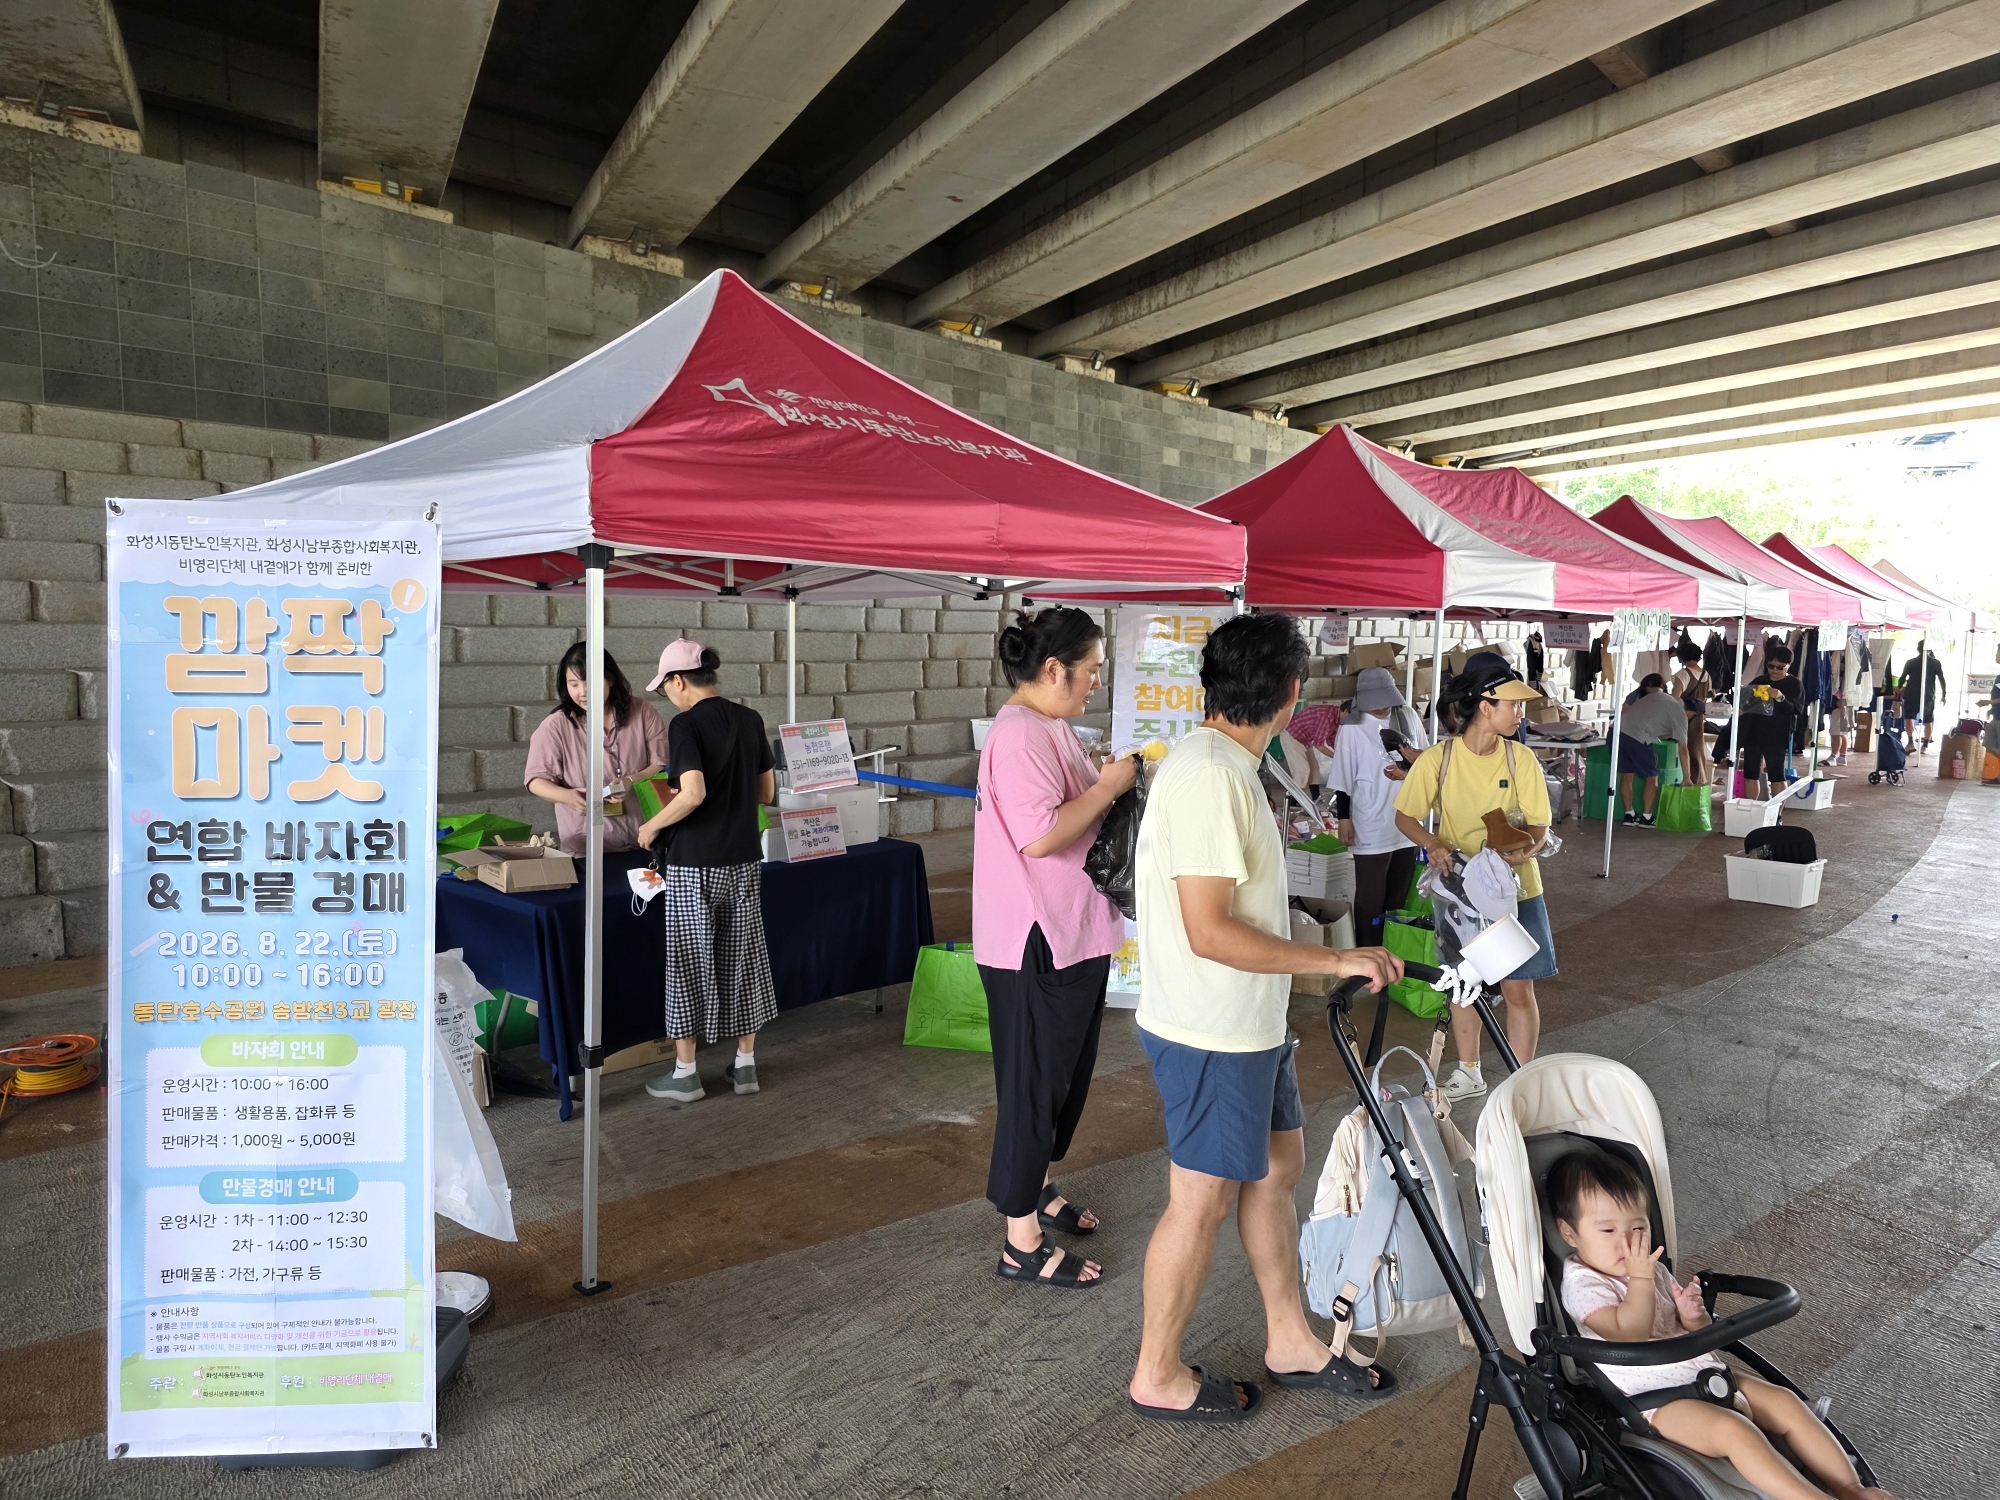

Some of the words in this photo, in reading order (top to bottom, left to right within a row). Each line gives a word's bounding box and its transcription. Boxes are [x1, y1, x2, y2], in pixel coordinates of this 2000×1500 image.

[778, 402, 1033, 466] 화성시동탄노인복지관
[126, 535, 262, 553] 화성시동탄노인복지관,
[265, 537, 422, 555] 화성시남부종합사회복지관,
[179, 558, 247, 575] 비영리단체
[250, 559, 302, 576] 내곁애가
[306, 561, 333, 576] 함께
[336, 561, 372, 577] 준비한
[1152, 615, 1213, 644] 지금
[163, 595, 395, 695] 깜짝
[172, 705, 386, 802] 마켓
[804, 740, 832, 754] 농협은행
[792, 753, 849, 770] 351-1169-9020-13
[803, 817, 820, 827] 계산은
[146, 817, 248, 863] 연합
[264, 818, 407, 863] 바자회
[801, 836, 830, 848] 가능합니다
[147, 872, 181, 911] &
[200, 871, 296, 914] 만물
[311, 871, 407, 914] 경매
[158, 931, 249, 957] 2026.
[258, 931, 285, 957] 8.
[172, 962, 263, 987] 10:00
[296, 962, 385, 987] 16:00
[133, 1000, 266, 1022] 동탄호수공원
[272, 1000, 371, 1022] 송방천3교
[377, 999, 417, 1021] 광장
[231, 1040, 285, 1060] 바자회
[290, 1040, 325, 1060] 안내
[161, 1078, 218, 1093] 운영시간
[231, 1078, 272, 1092] 10:00
[288, 1078, 329, 1091] 16:00
[161, 1106, 218, 1122] 판매물품
[234, 1105, 292, 1121] 생활용품,
[295, 1105, 339, 1120] 잡화류
[342, 1104, 357, 1119] 등
[161, 1134, 218, 1150] 판매가격
[232, 1133, 283, 1150] 1,000원
[300, 1131, 356, 1148] 5,000원
[222, 1177, 293, 1198] 만물경매
[297, 1176, 335, 1196] 안내
[159, 1214, 217, 1230] 운영시간
[234, 1213, 254, 1228] 1차
[268, 1212, 309, 1226] 11:00
[327, 1210, 368, 1225] 12:30
[231, 1238, 254, 1253] 2차
[267, 1238, 309, 1252] 14:00
[327, 1236, 368, 1250] 15:30
[160, 1267, 217, 1284] 판매물품
[229, 1267, 259, 1283] 가전,
[262, 1266, 304, 1282] 가구류
[307, 1265, 322, 1281] 등
[161, 1306, 199, 1318] 안내사항
[266, 1321, 279, 1330] 있어
[281, 1320, 309, 1329] 구체적인
[311, 1319, 332, 1328] 안내가
[202, 1332, 229, 1340] 지역사회
[173, 1344, 186, 1353] 구입
[188, 1344, 195, 1352] 시
[365, 1339, 378, 1348] 사용
[150, 1376, 176, 1390] 주관
[280, 1374, 304, 1388] 후원
[319, 1373, 363, 1387] 비영리단체
